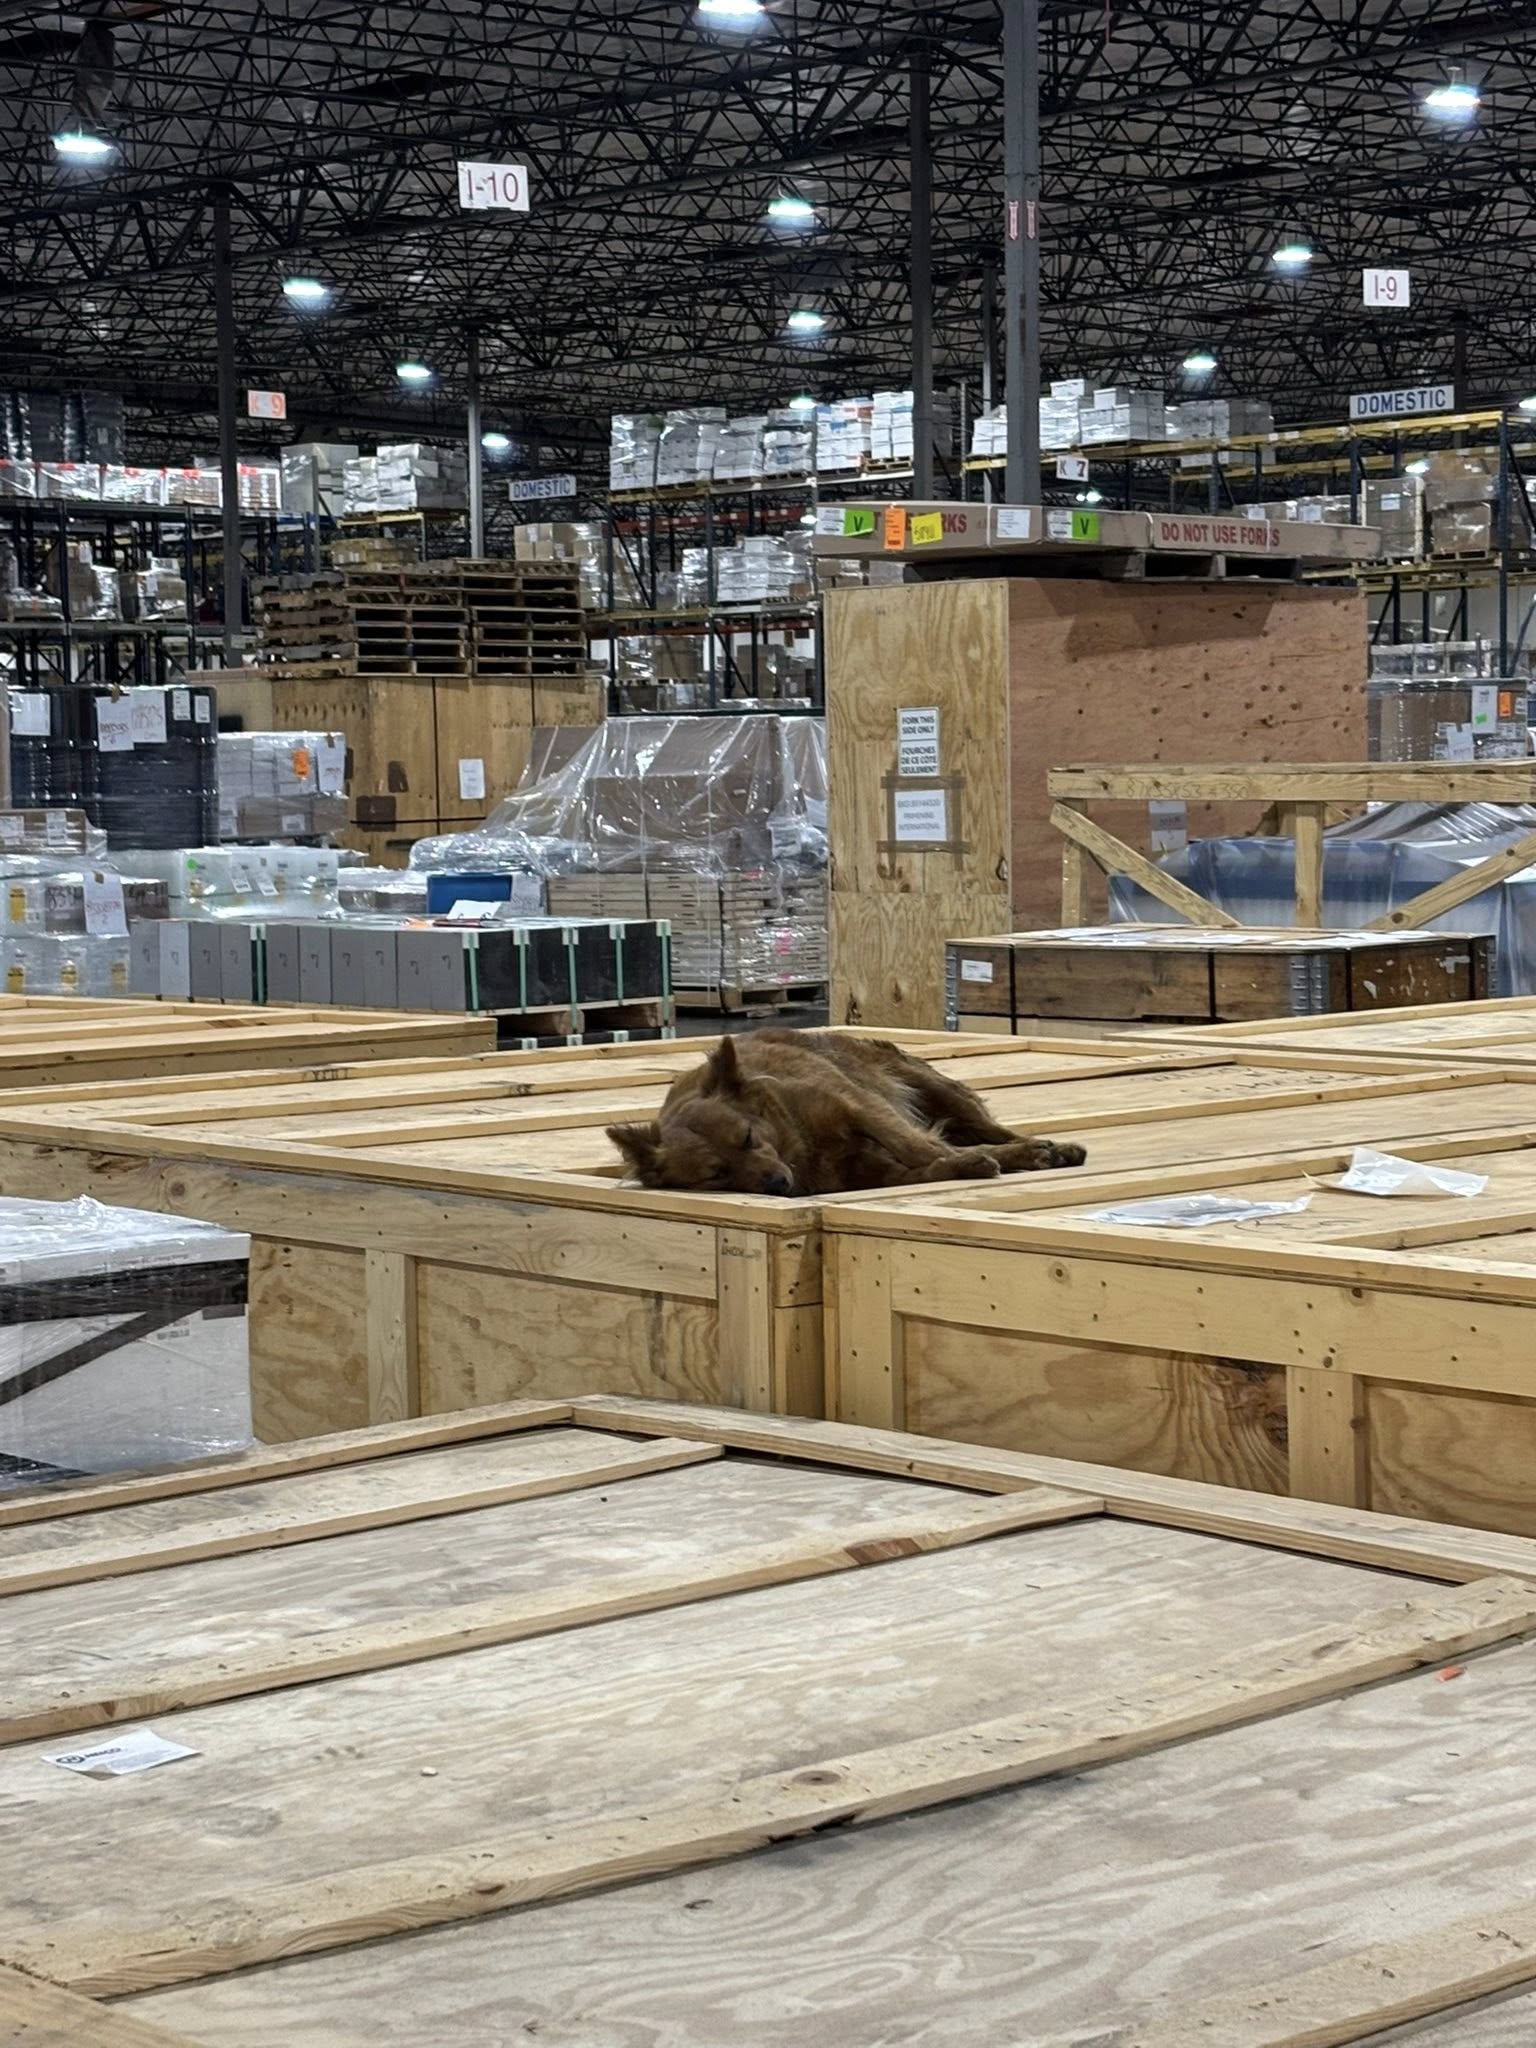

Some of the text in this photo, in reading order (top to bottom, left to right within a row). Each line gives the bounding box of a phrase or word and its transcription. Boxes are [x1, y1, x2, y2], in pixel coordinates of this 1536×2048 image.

[467, 169, 519, 203] I-10
[1374, 274, 1397, 301] I-9
[1357, 389, 1446, 415] DOMESTIC
[513, 479, 571, 498] DOMESTIC
[853, 515, 864, 532] V
[1080, 517, 1090, 535] V
[1161, 522, 1180, 541] DO
[1182, 523, 1209, 543] NOT
[1212, 524, 1238, 544] USE
